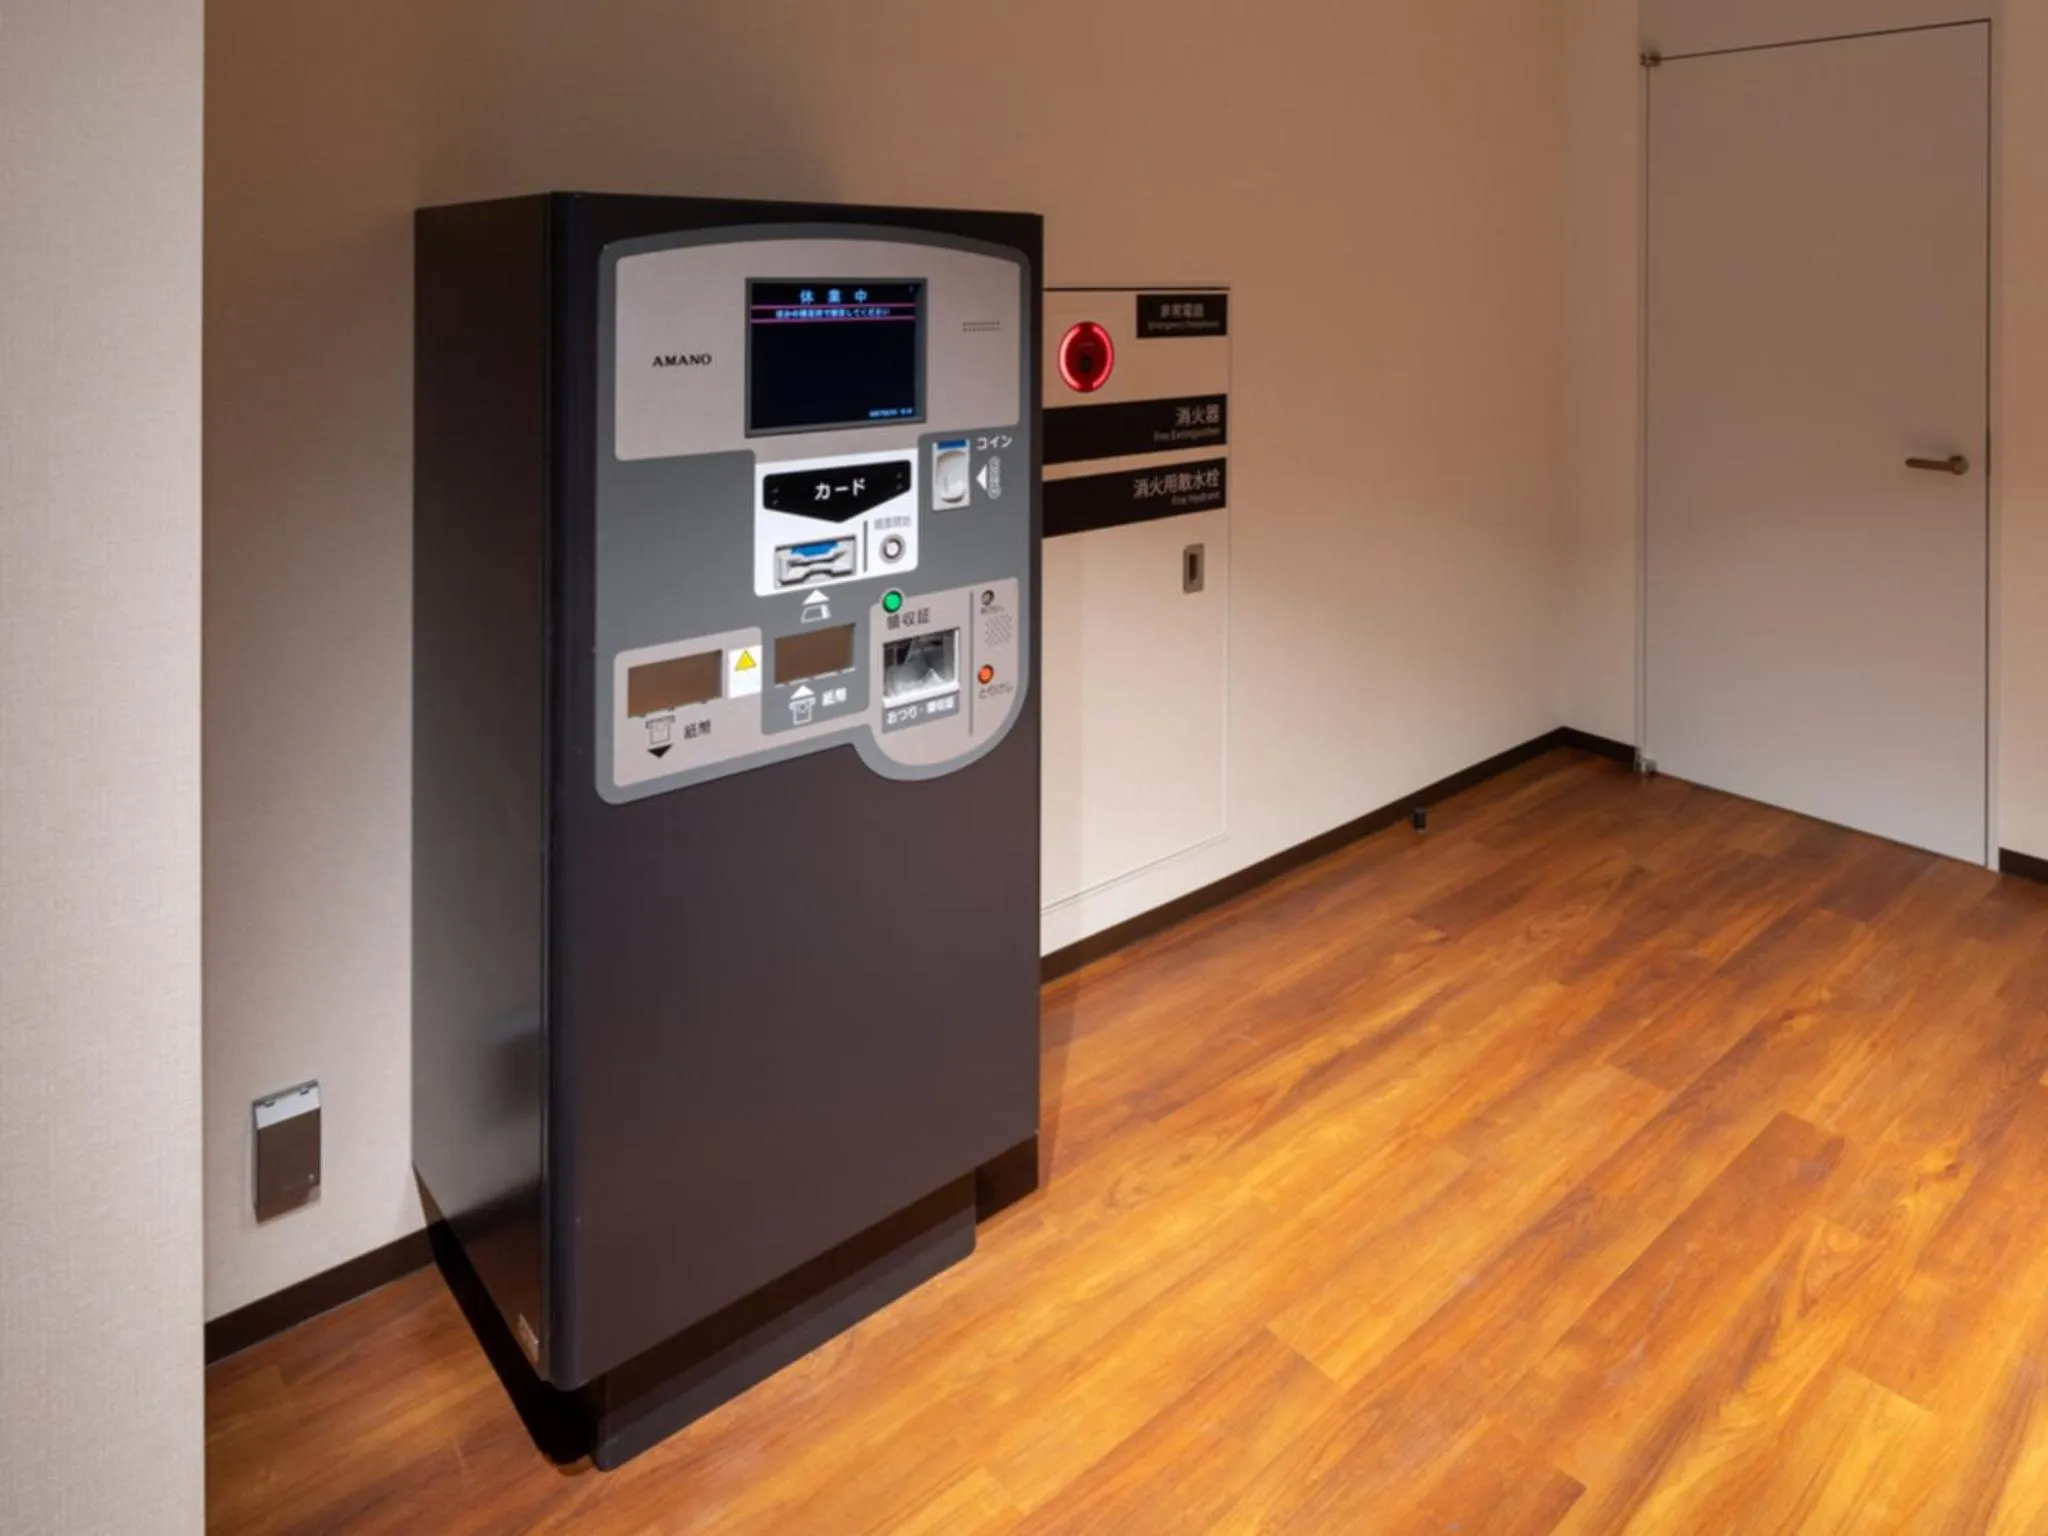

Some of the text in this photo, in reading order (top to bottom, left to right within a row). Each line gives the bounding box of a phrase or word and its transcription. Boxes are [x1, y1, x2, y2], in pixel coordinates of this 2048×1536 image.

[651, 353, 713, 368] AMANO
[1176, 403, 1220, 426] 消火器
[976, 434, 1013, 451] コイン
[814, 477, 866, 501] カード
[1133, 467, 1220, 499] 消火用散水栓
